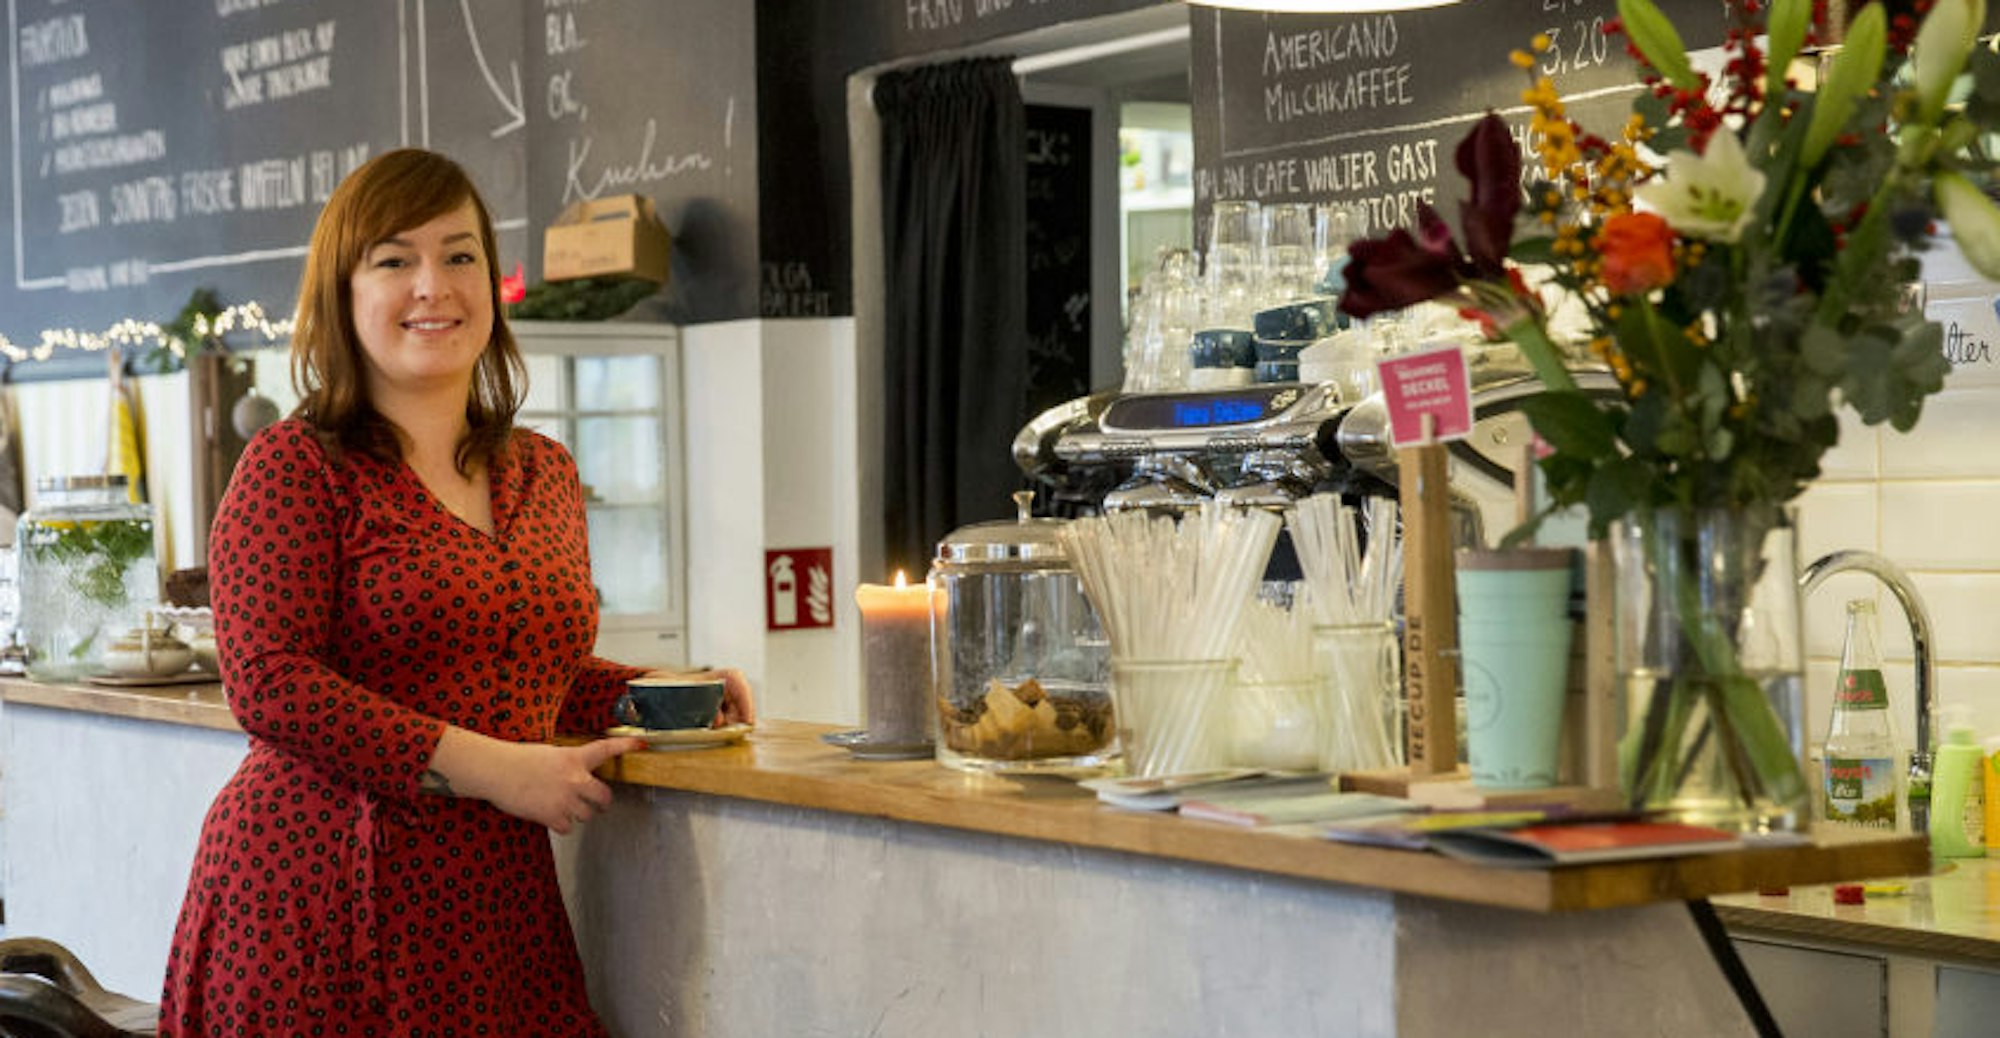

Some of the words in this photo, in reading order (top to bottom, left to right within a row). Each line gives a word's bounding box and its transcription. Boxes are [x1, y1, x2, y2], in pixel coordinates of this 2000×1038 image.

[1263, 14, 1398, 76] AMERICANO
[1542, 16, 1606, 75] 3,20
[1263, 63, 1414, 123] MILCHKAFFEE
[1303, 150, 1379, 192] WALTER
[1387, 138, 1438, 184] GAST
